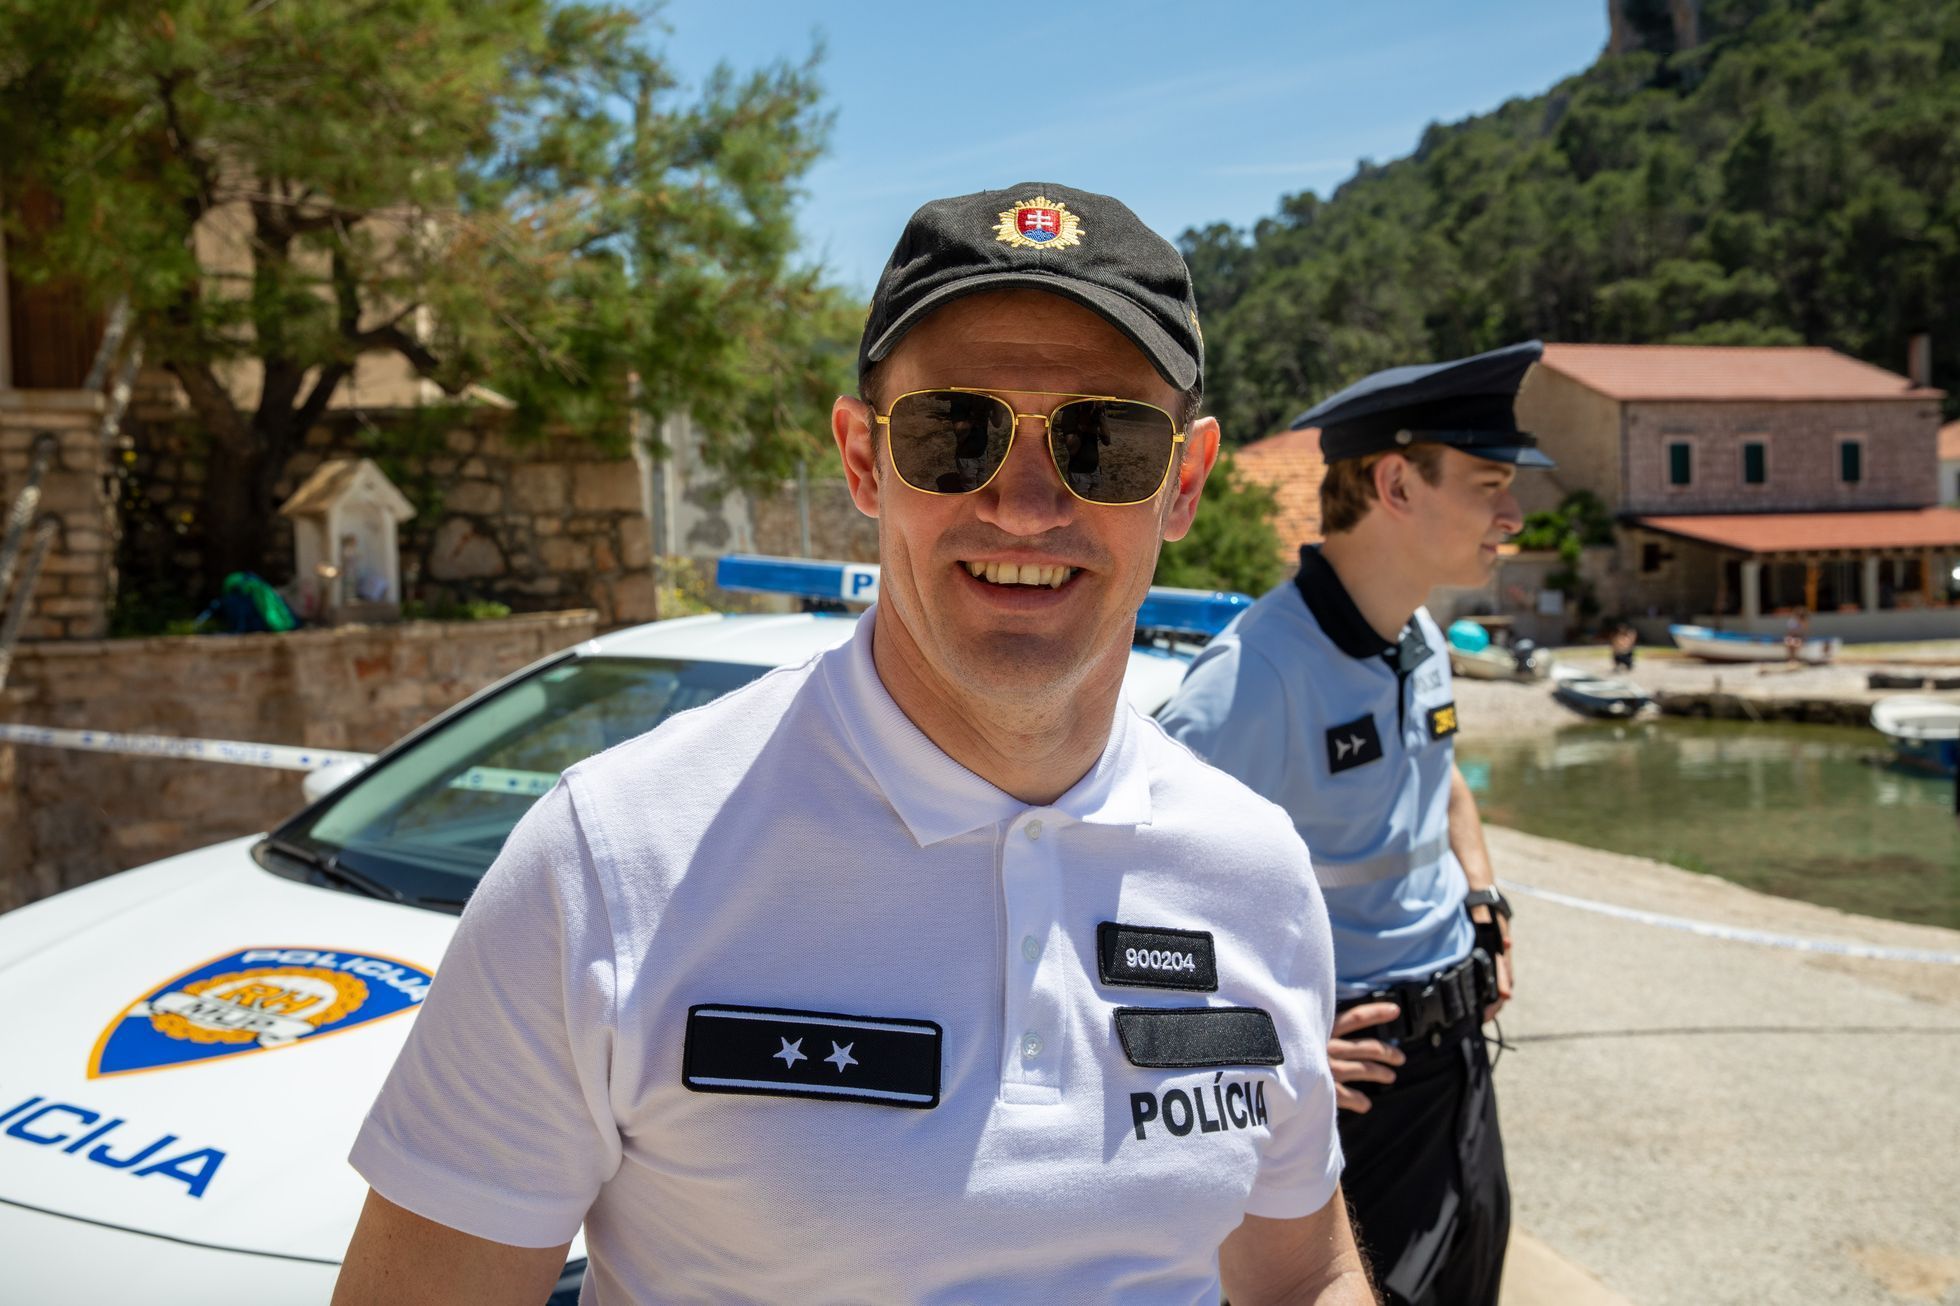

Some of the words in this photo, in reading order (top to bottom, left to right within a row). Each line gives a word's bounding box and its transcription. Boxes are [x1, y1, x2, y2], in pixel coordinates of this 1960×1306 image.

[241, 950, 432, 1002] POLICIJA
[1125, 948, 1195, 972] 900204
[1130, 1072, 1267, 1140] POLÍCIA
